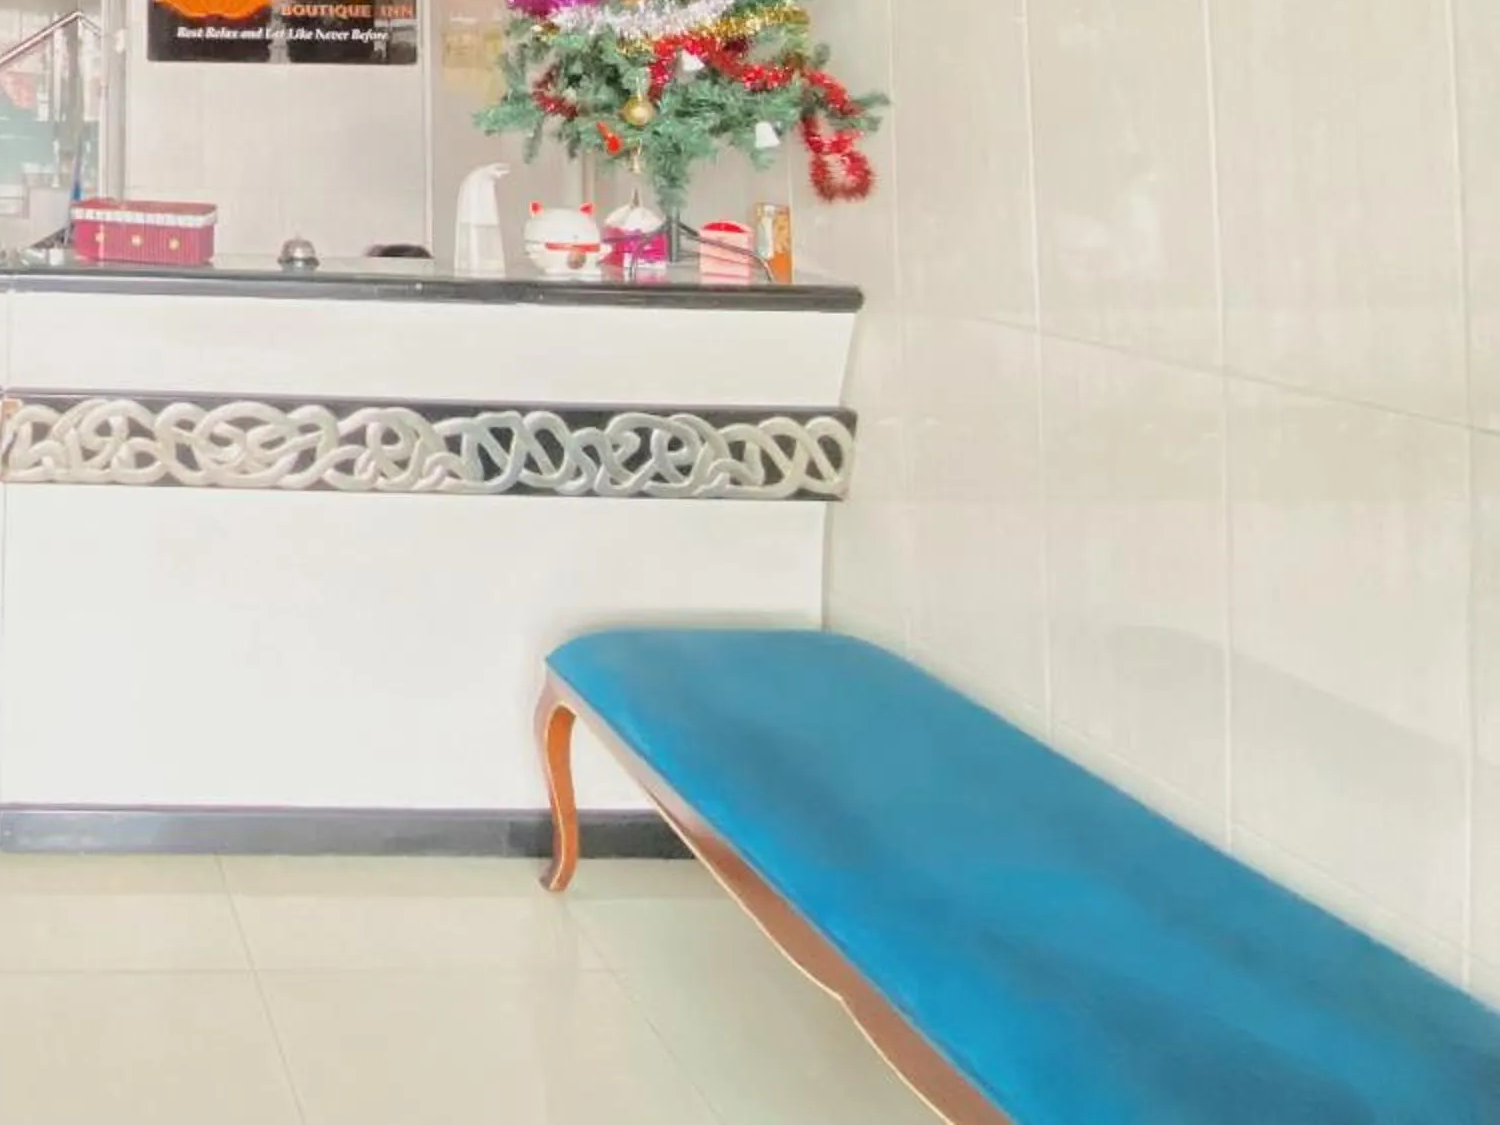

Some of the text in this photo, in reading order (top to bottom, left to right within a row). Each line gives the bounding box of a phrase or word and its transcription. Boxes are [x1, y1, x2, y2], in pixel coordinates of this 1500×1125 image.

[281, 4, 414, 19] BOUTIQUE INN
[240, 27, 263, 39] and
[288, 27, 314, 40] Like
[315, 27, 350, 40] Never
[351, 27, 388, 43] Before
